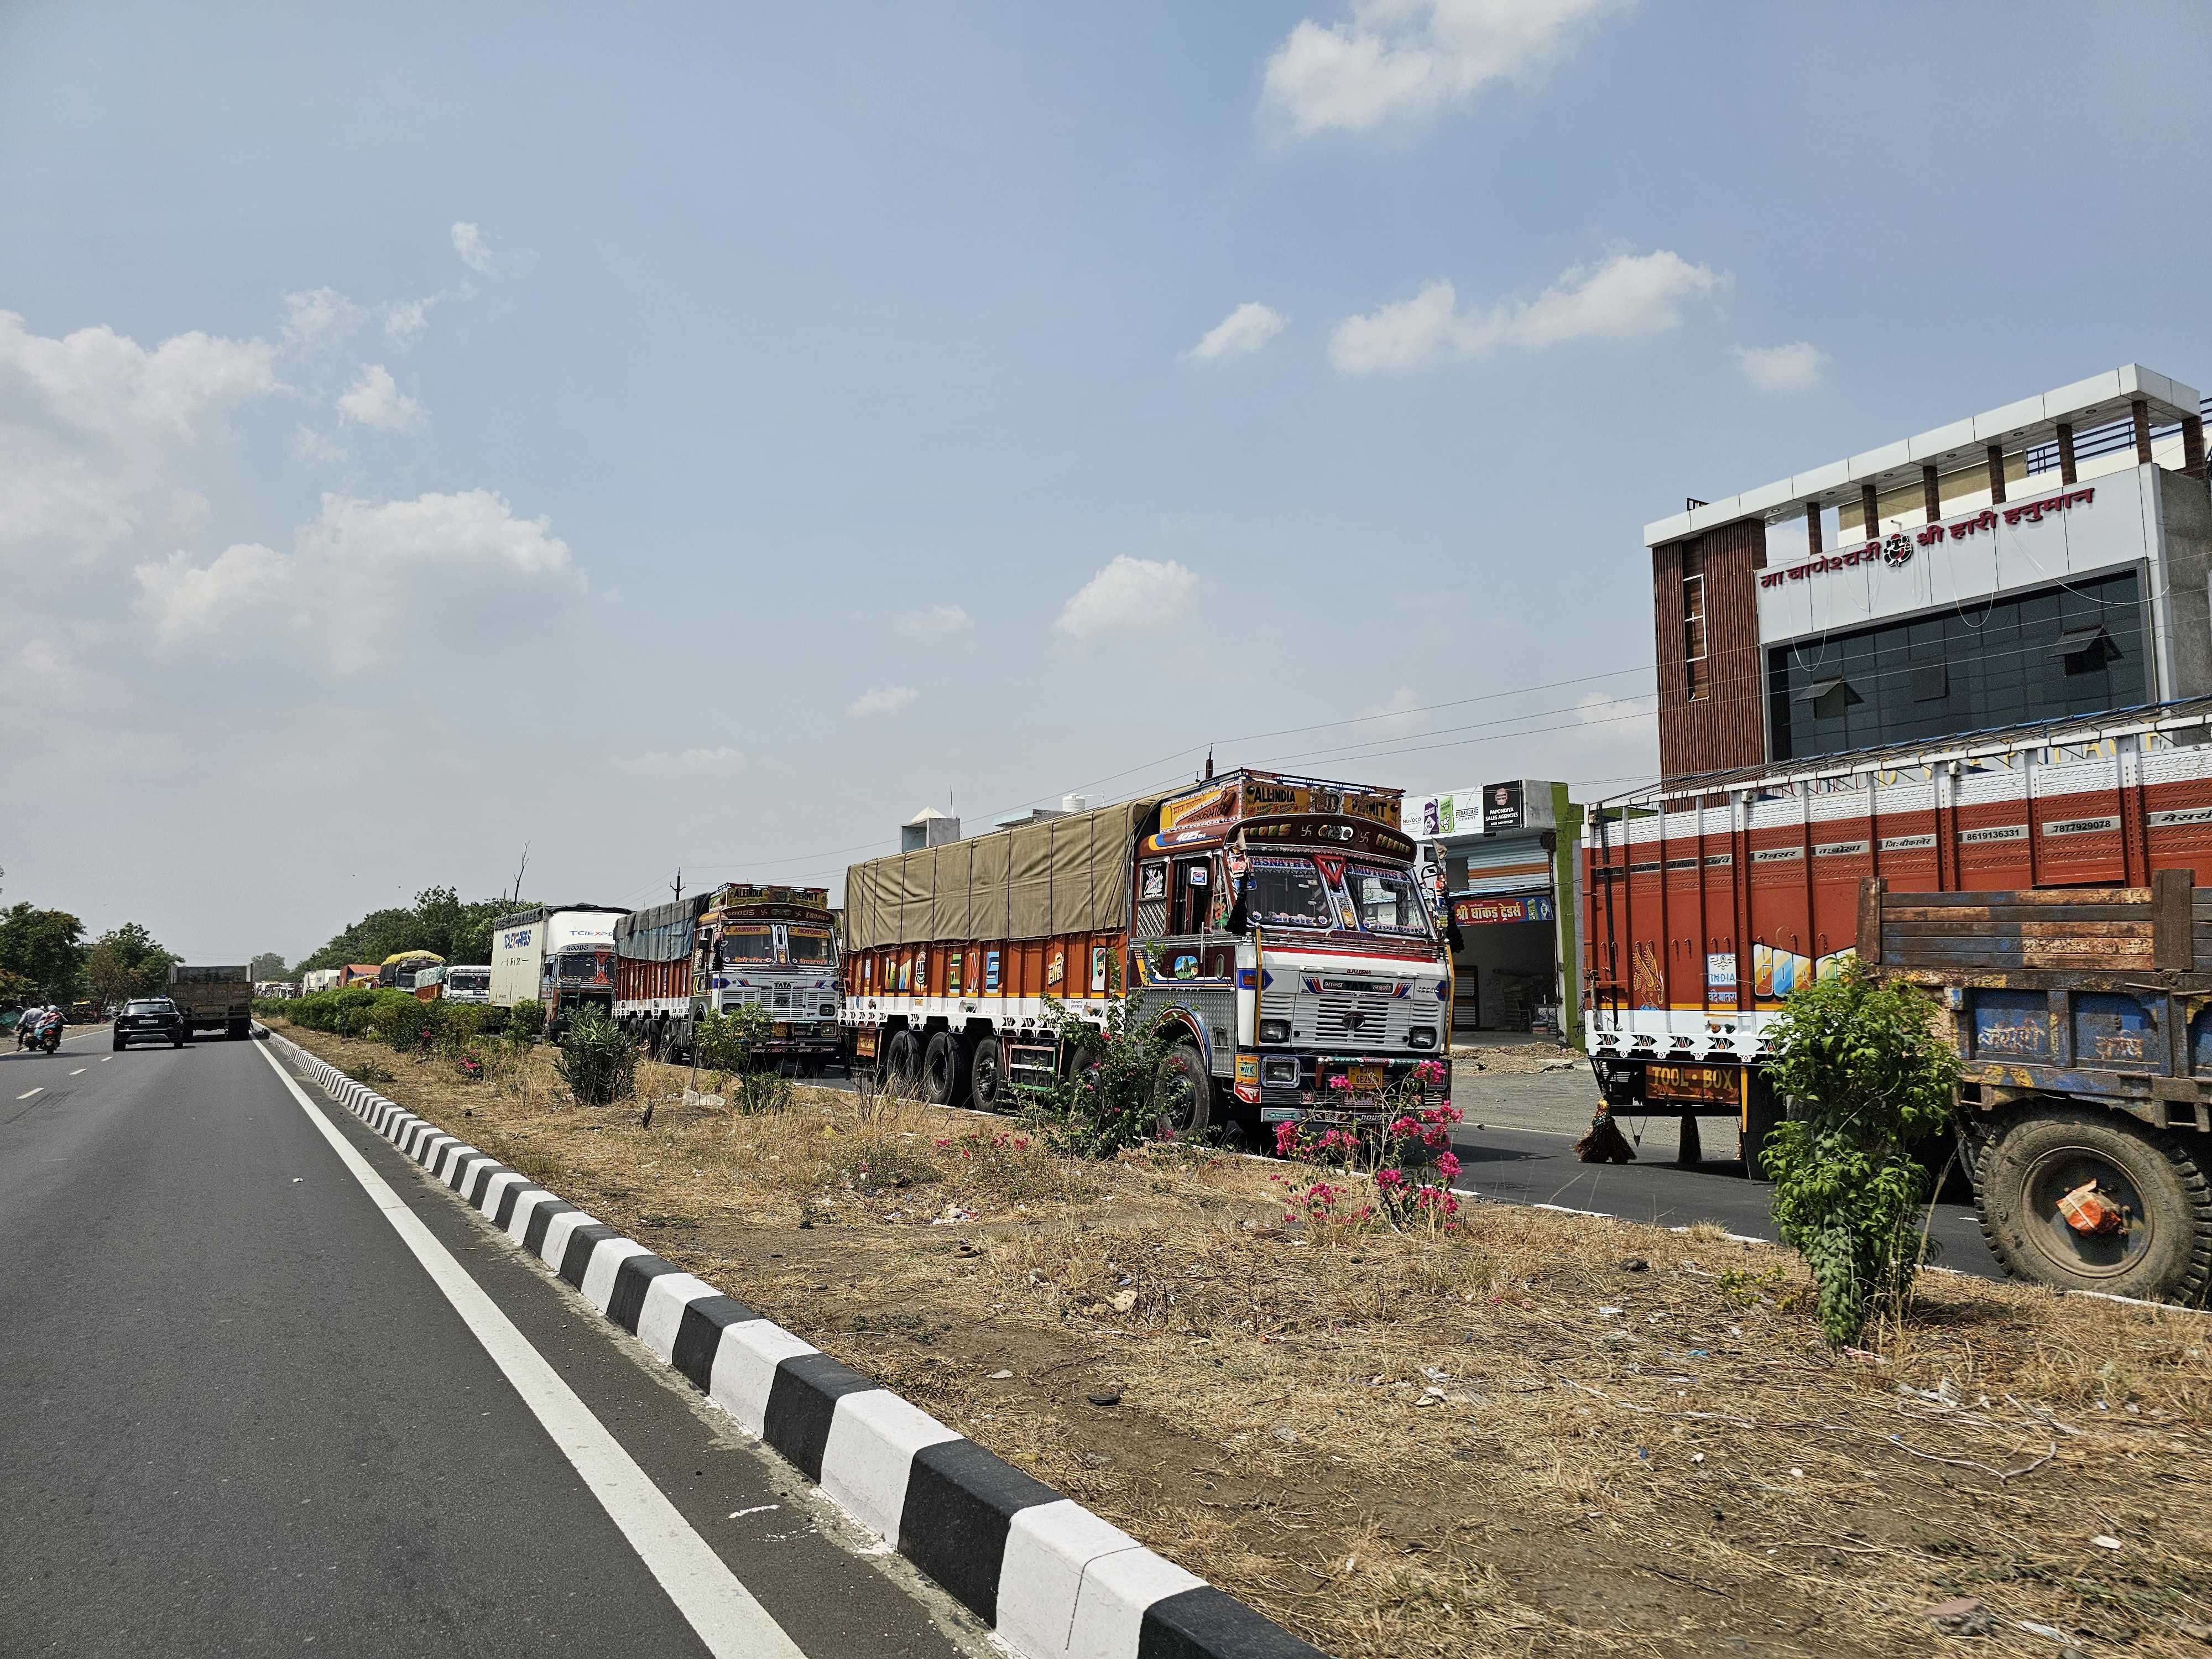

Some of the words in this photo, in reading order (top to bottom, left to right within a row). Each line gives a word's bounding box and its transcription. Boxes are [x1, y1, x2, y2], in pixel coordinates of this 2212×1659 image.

[1916, 524, 1944, 547] श्री
[2002, 487, 2095, 526] हनुमान
[1352, 798, 1387, 818] PMIT
[2053, 820, 2111, 833] 7877929078
[1966, 829, 2020, 841] 8619136331
[1455, 905, 1468, 921] श्री
[1710, 973, 1736, 983] INDIA
[1651, 1066, 1689, 1088] TOOL
[1703, 1068, 1734, 1091] BOX
